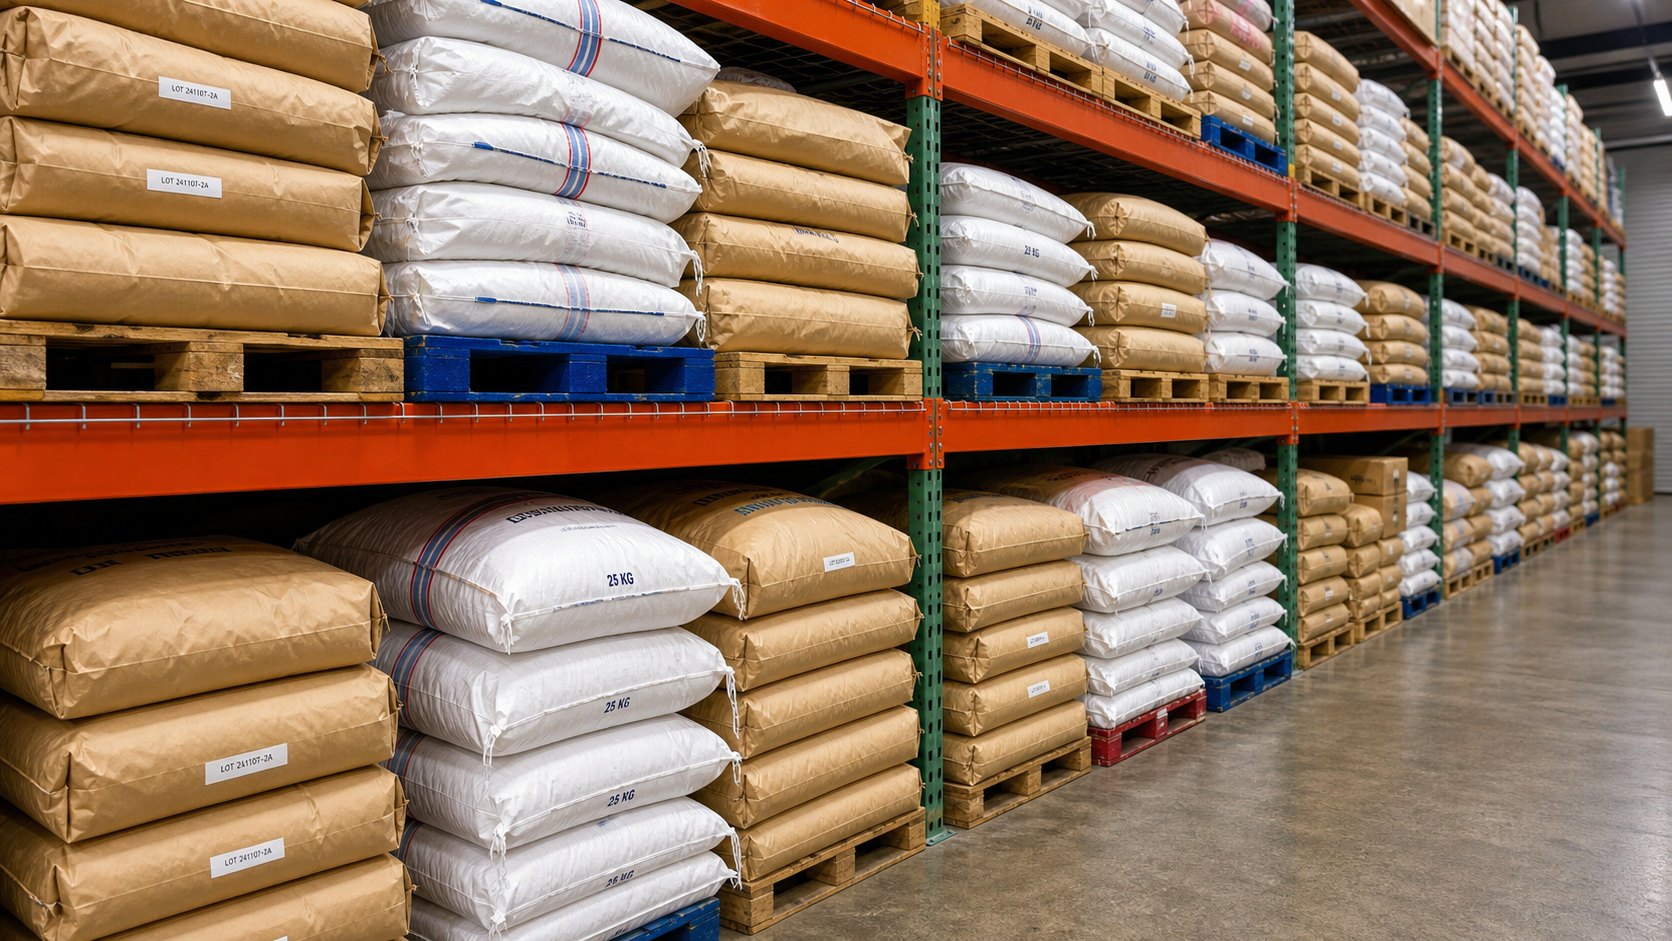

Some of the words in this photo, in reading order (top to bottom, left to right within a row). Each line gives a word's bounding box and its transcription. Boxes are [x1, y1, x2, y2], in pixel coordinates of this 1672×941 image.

[171, 85, 184, 93] LOT
[607, 573, 619, 587] 25
[620, 571, 634, 585] KG
[604, 700, 616, 713] 25
[220, 763, 235, 773] LOT
[607, 794, 620, 807] 25
[224, 856, 237, 867] LOT
